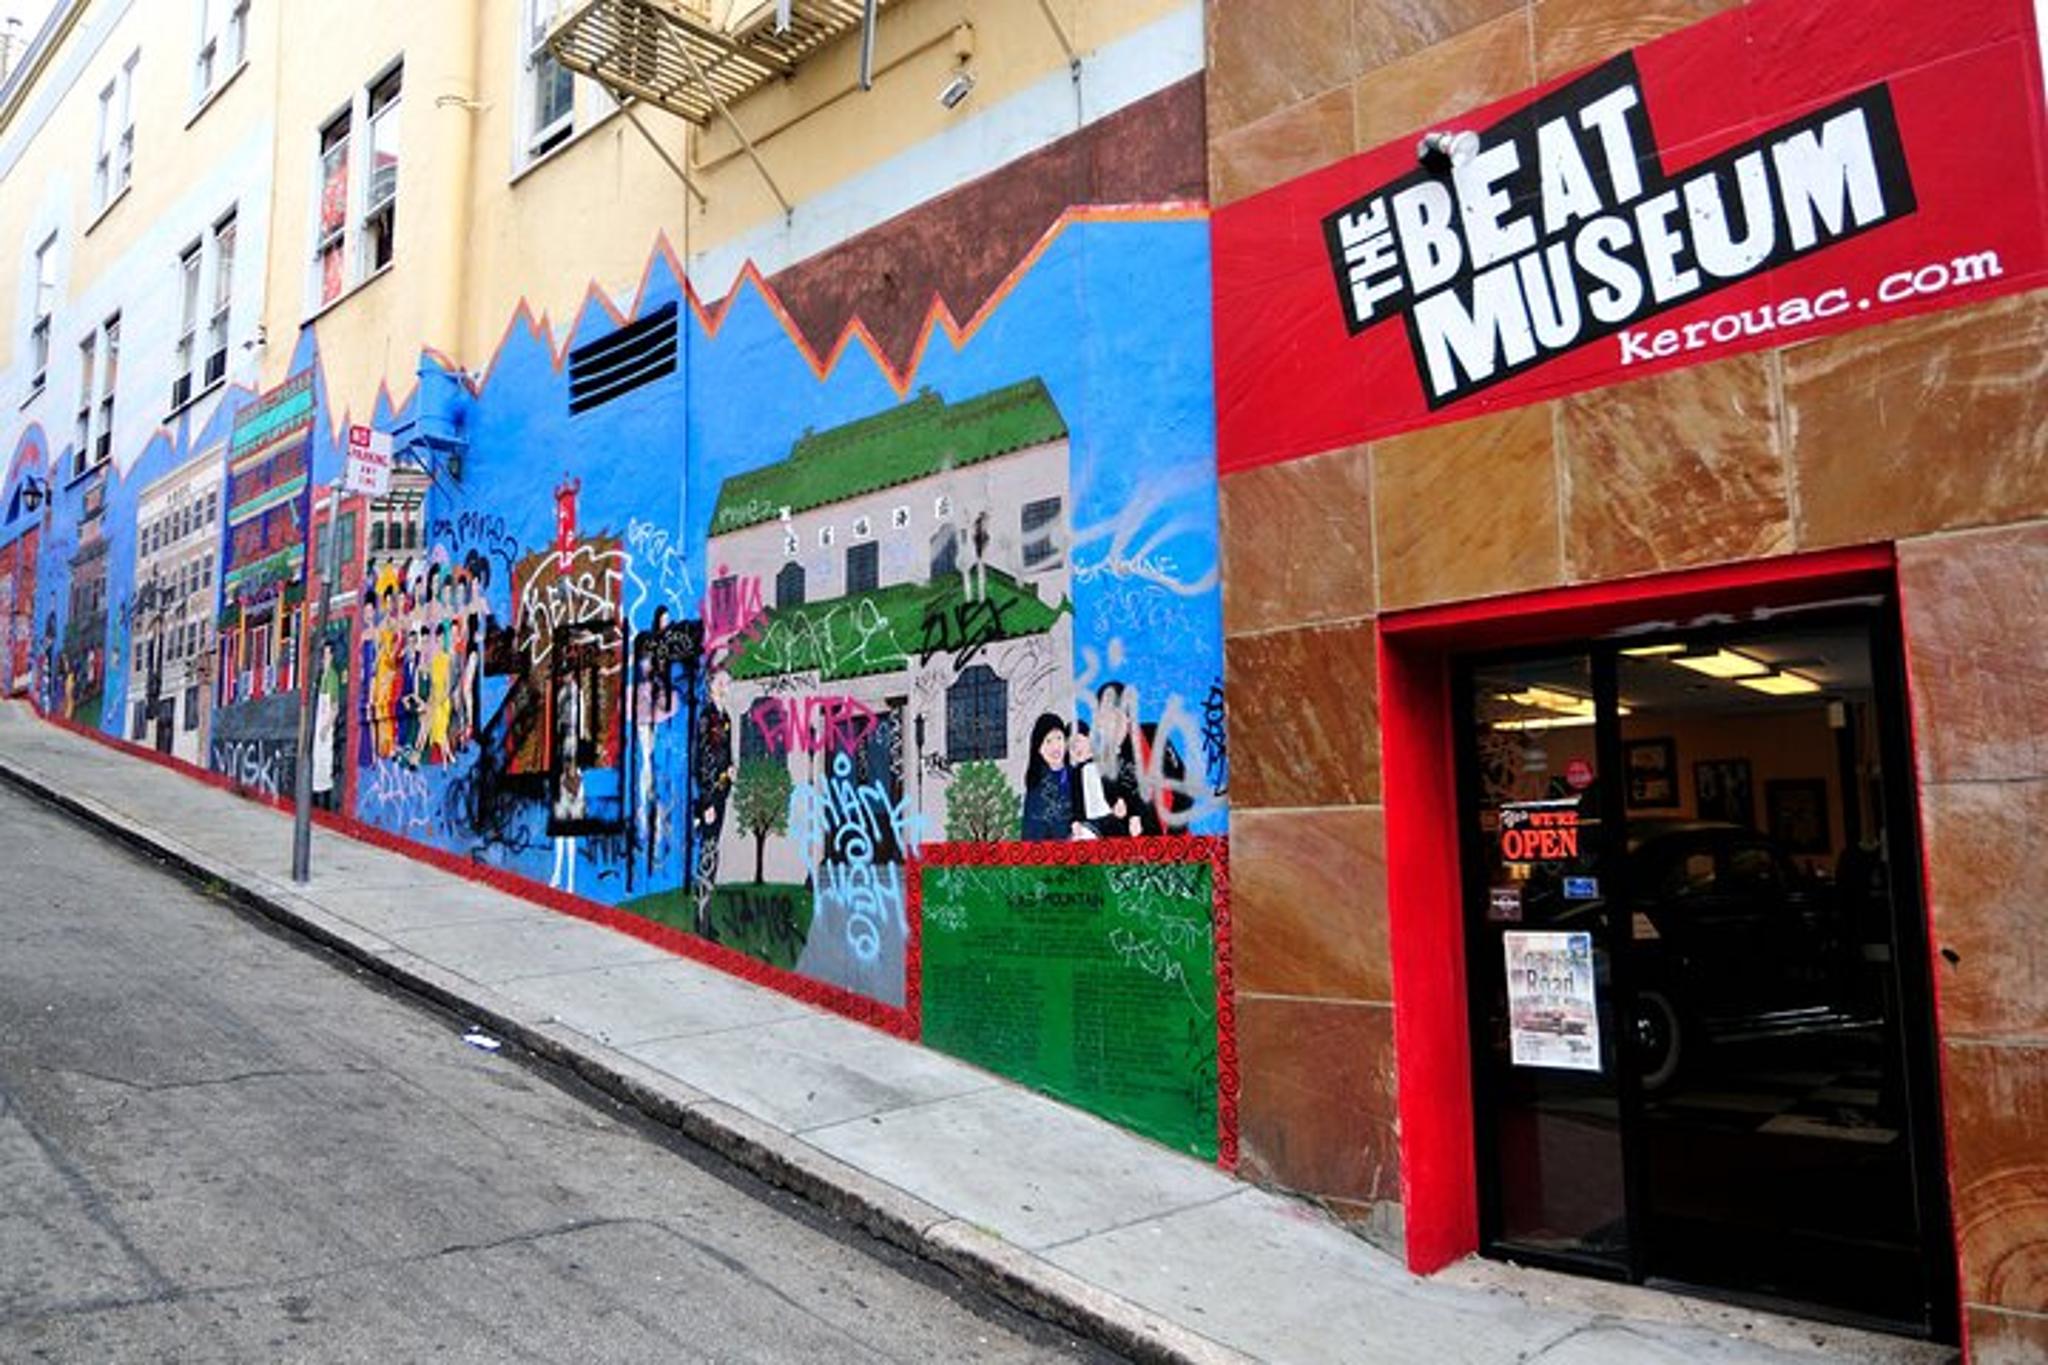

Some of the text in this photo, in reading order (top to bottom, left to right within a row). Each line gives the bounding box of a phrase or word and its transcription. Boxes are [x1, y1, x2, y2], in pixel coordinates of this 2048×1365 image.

[1393, 83, 1644, 298] BEAT
[1343, 196, 1403, 321] THE
[1412, 107, 1886, 400] MUSEUM
[1618, 247, 2004, 366] kerouac.com
[352, 428, 369, 445] NO
[1502, 828, 1579, 861] OPEN
